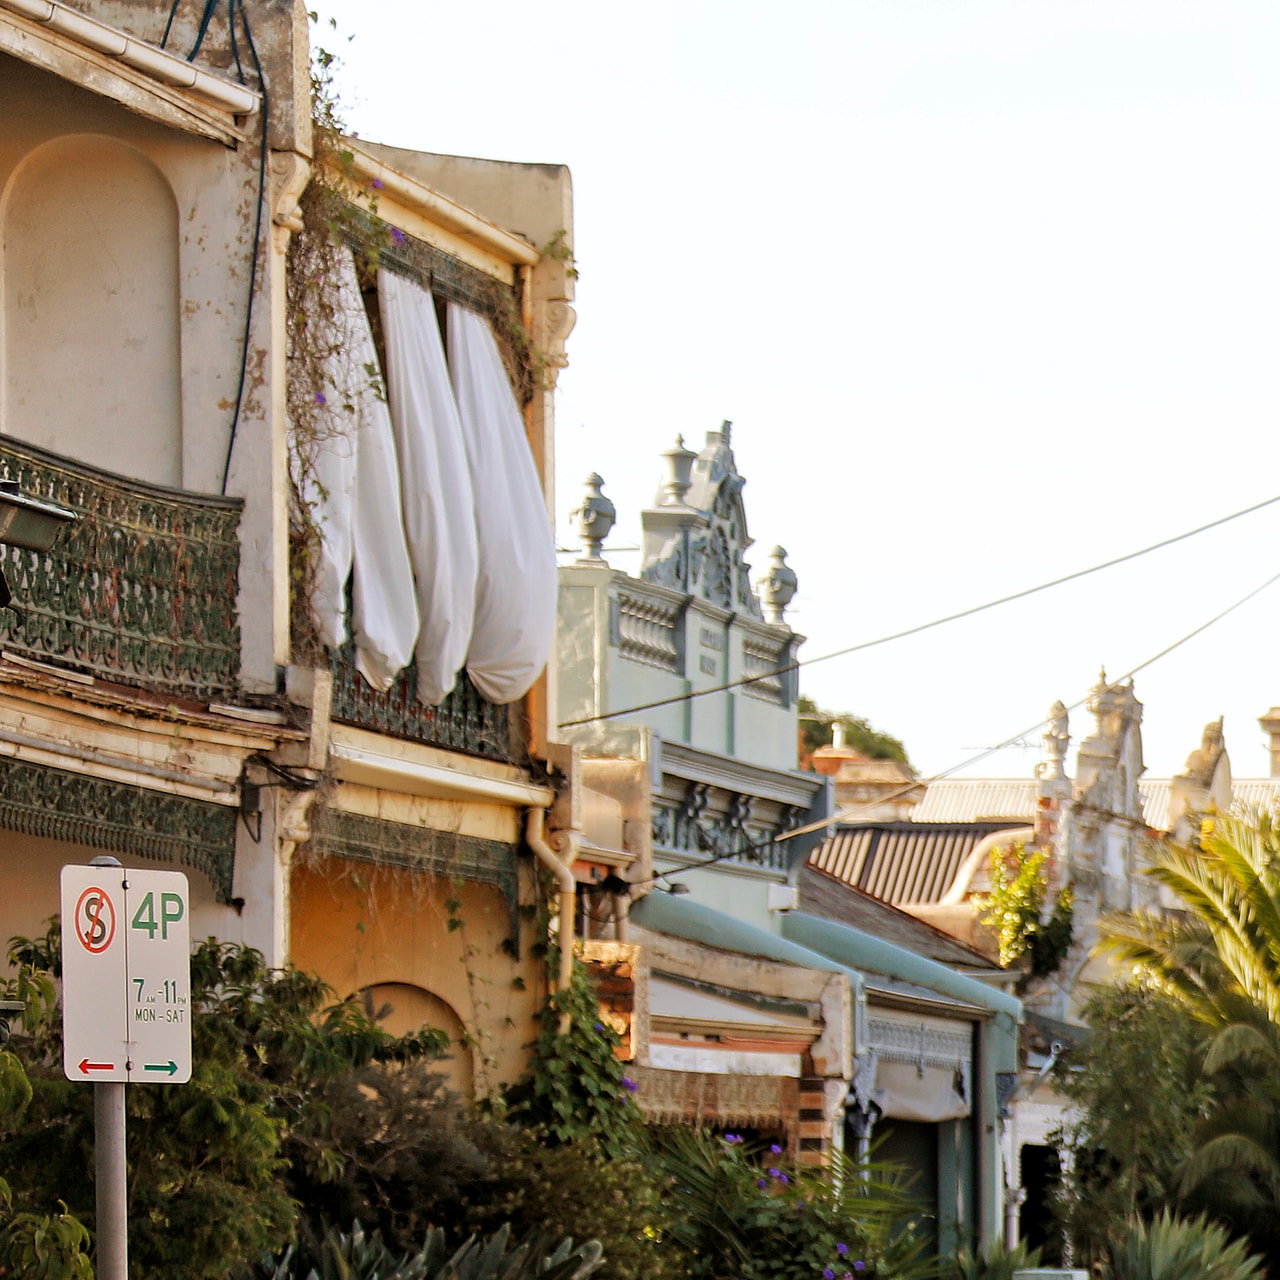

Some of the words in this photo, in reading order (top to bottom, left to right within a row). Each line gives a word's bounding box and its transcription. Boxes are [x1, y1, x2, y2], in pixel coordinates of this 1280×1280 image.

[131, 892, 184, 940] 4P
[135, 1009, 155, 1021] MON
[166, 1009, 185, 1022] SAT
